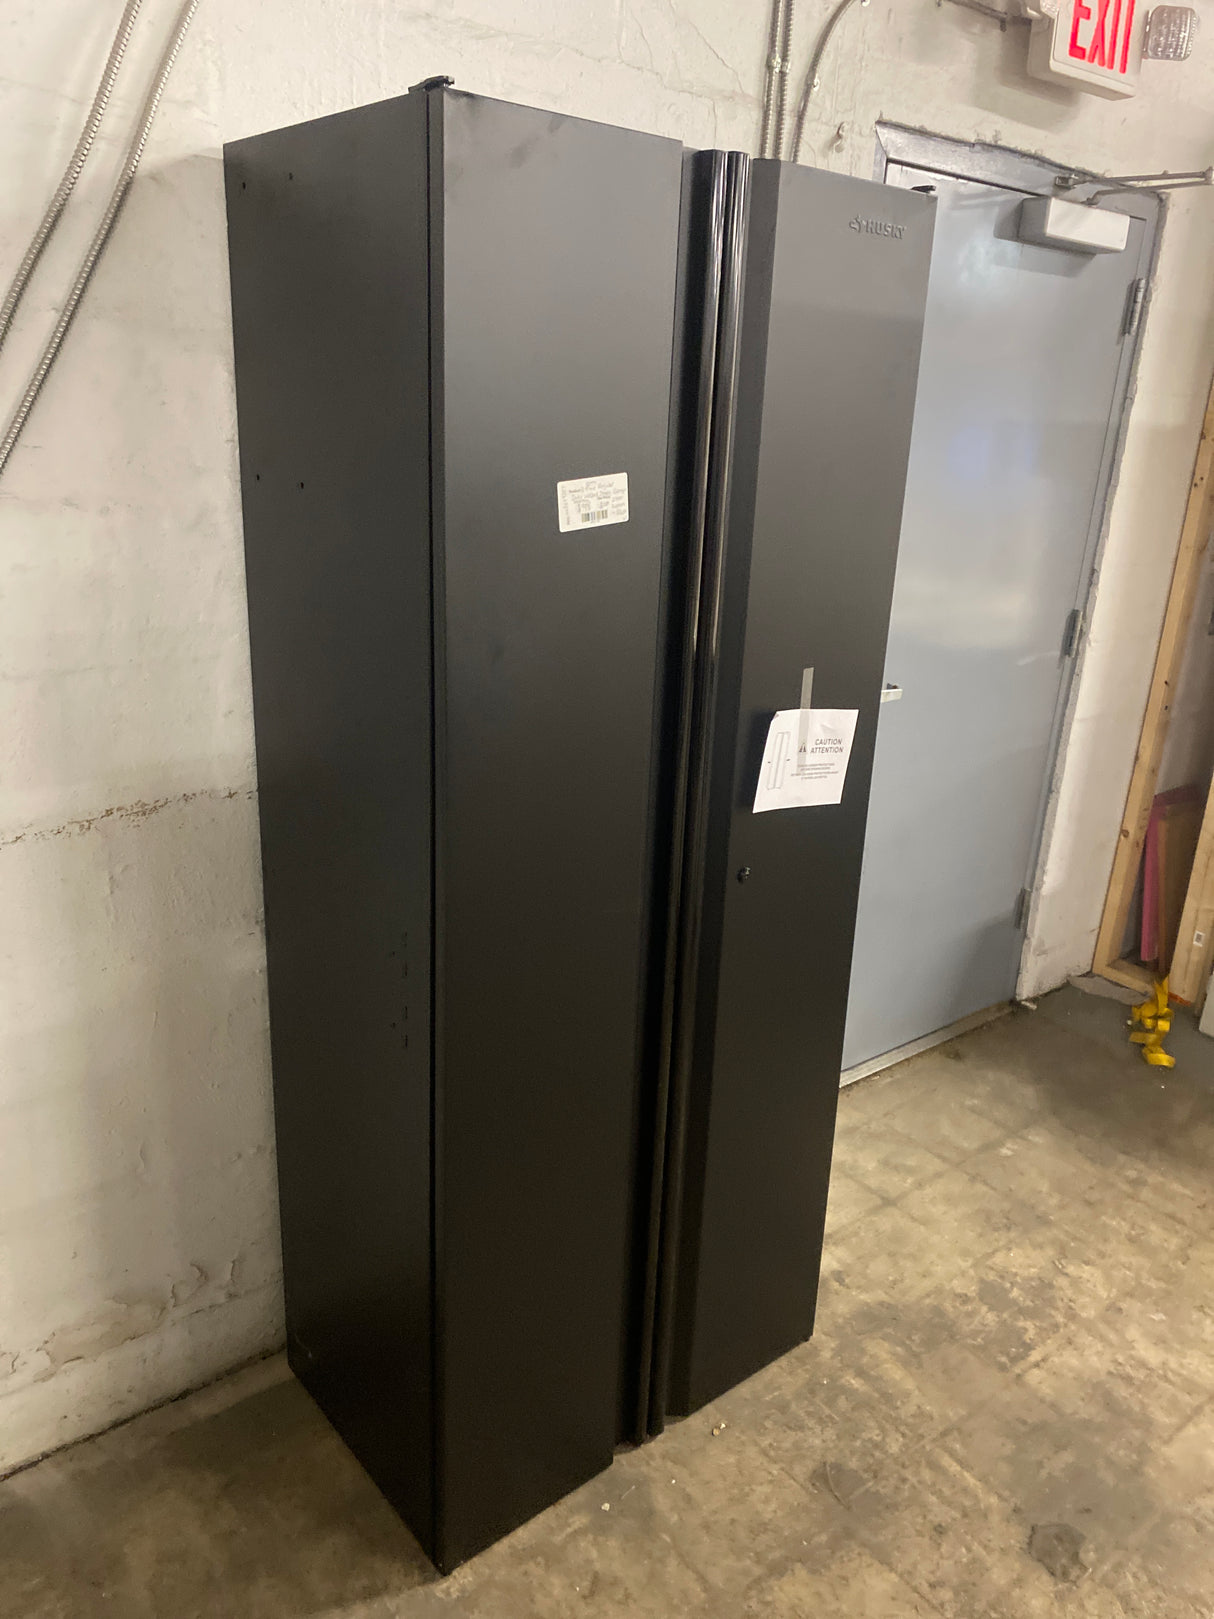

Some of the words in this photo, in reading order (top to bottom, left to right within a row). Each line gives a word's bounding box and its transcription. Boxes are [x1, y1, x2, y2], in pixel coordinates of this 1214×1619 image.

[865, 219, 906, 240] HUSKY
[814, 738, 843, 746] CAUTION
[810, 746, 844, 754] ATTENTION
